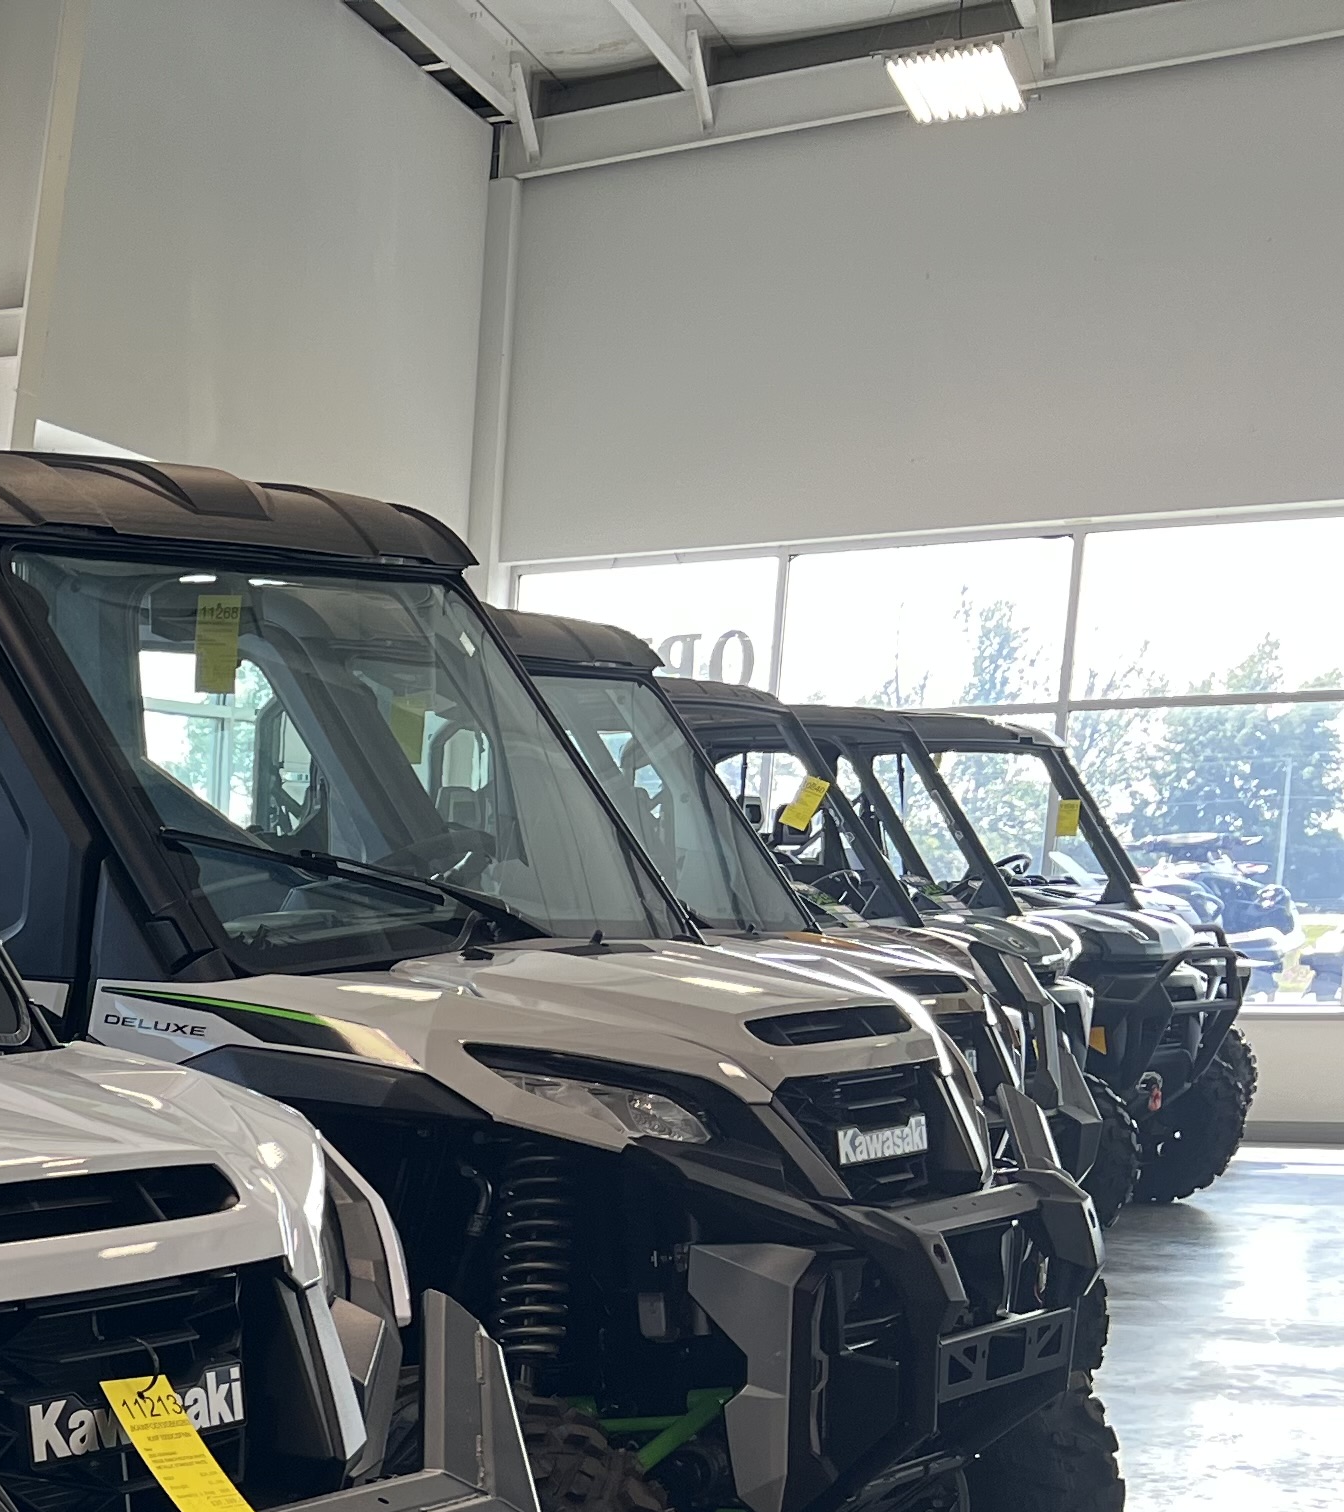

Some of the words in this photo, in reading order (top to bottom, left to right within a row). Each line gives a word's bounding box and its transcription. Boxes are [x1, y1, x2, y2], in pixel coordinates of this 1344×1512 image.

[104, 1014, 207, 1037] DELUXE
[838, 1115, 928, 1164] Kawasaki
[29, 1366, 244, 1463] Kawaki
[121, 1394, 183, 1420] 11213
